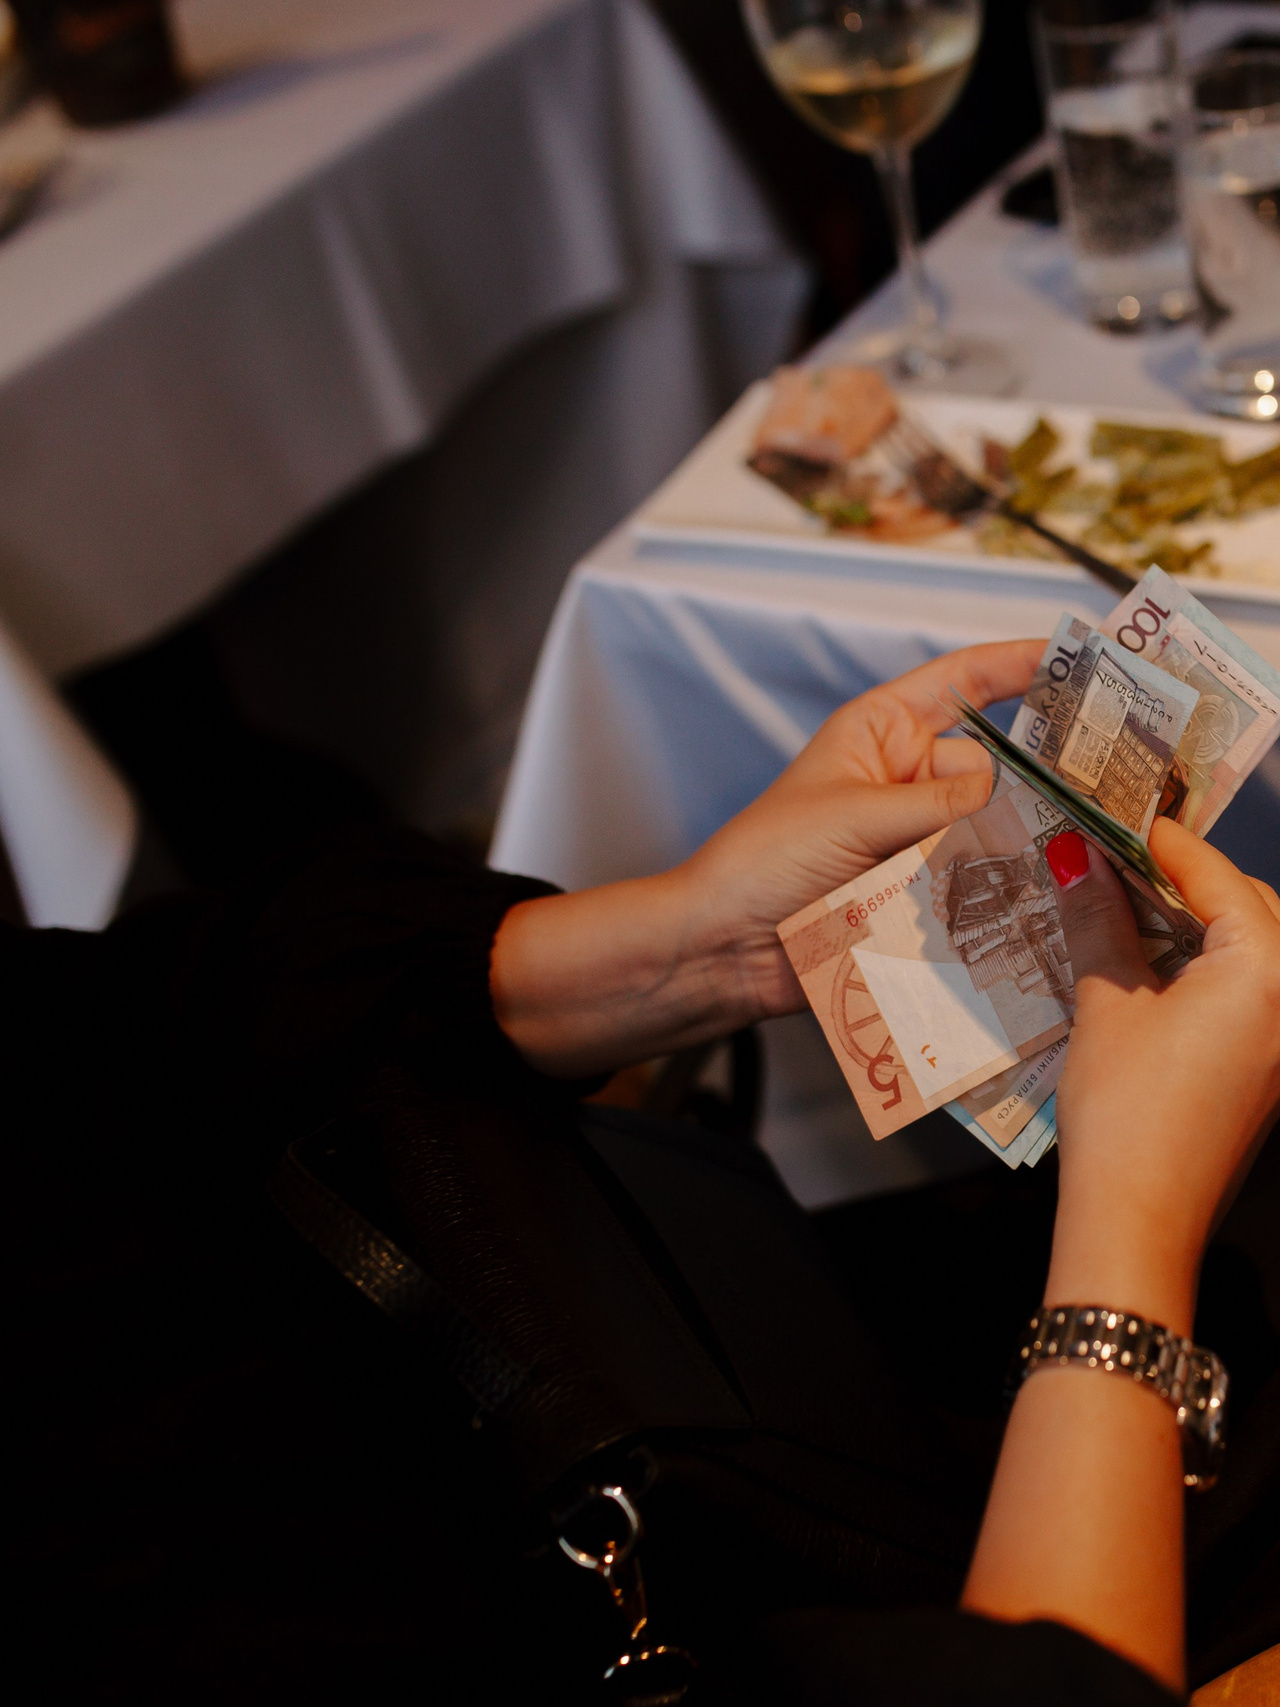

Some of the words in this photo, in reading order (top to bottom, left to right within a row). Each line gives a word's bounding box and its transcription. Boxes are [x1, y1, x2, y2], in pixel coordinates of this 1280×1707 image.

[1117, 597, 1171, 653] 100
[1047, 645, 1079, 683] 10
[867, 1054, 902, 1111] 5
[996, 1070, 1040, 1121] БЕЛАРУСЬ
